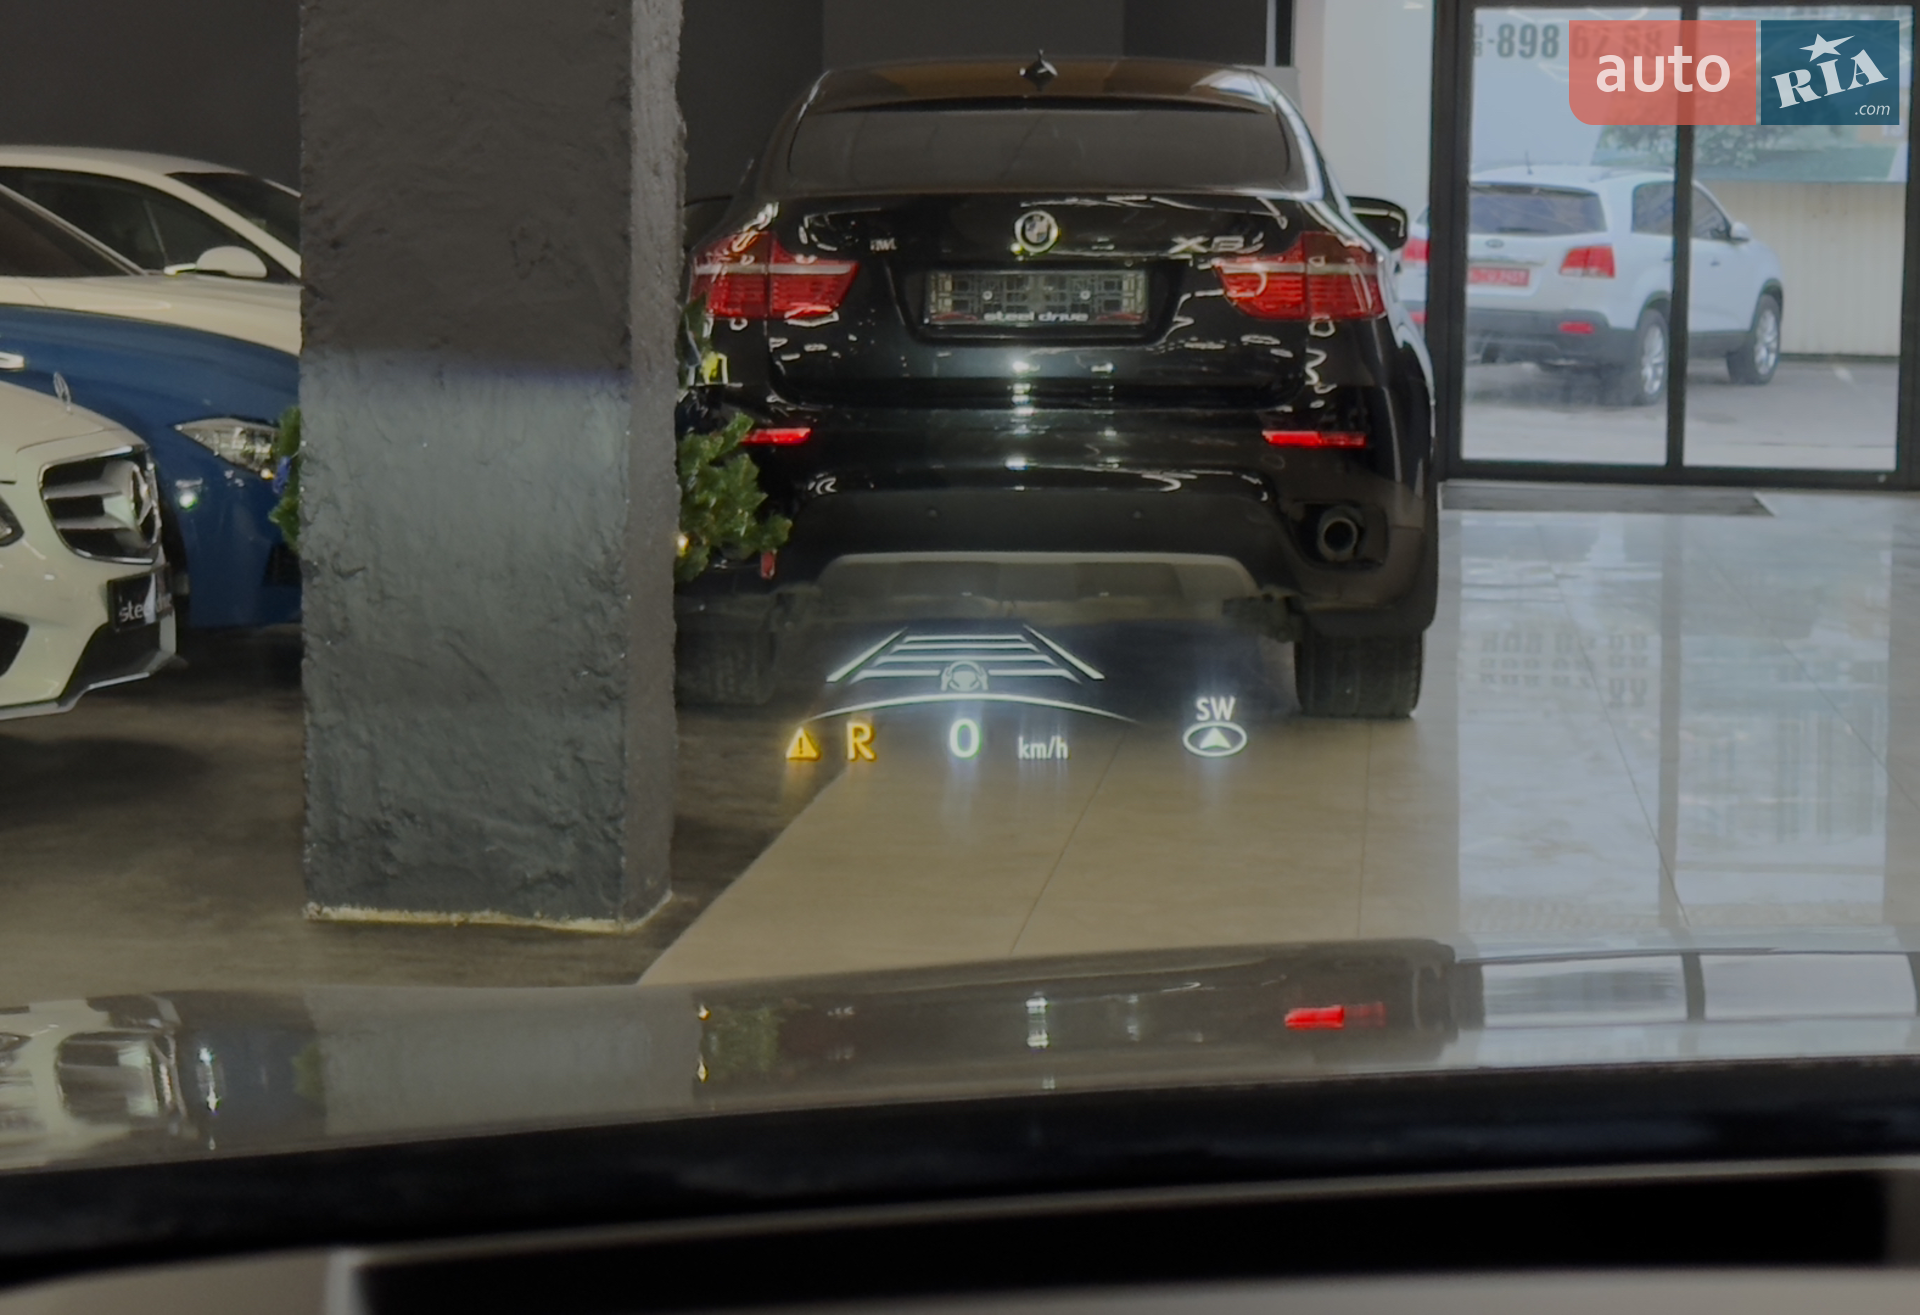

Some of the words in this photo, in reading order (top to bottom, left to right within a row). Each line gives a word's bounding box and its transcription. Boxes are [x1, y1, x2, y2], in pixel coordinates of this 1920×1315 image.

[1038, 310, 1089, 322] drive
[1195, 696, 1236, 720] SW
[845, 721, 876, 761] R
[948, 718, 982, 759] 0
[1017, 736, 1069, 760] km/h
